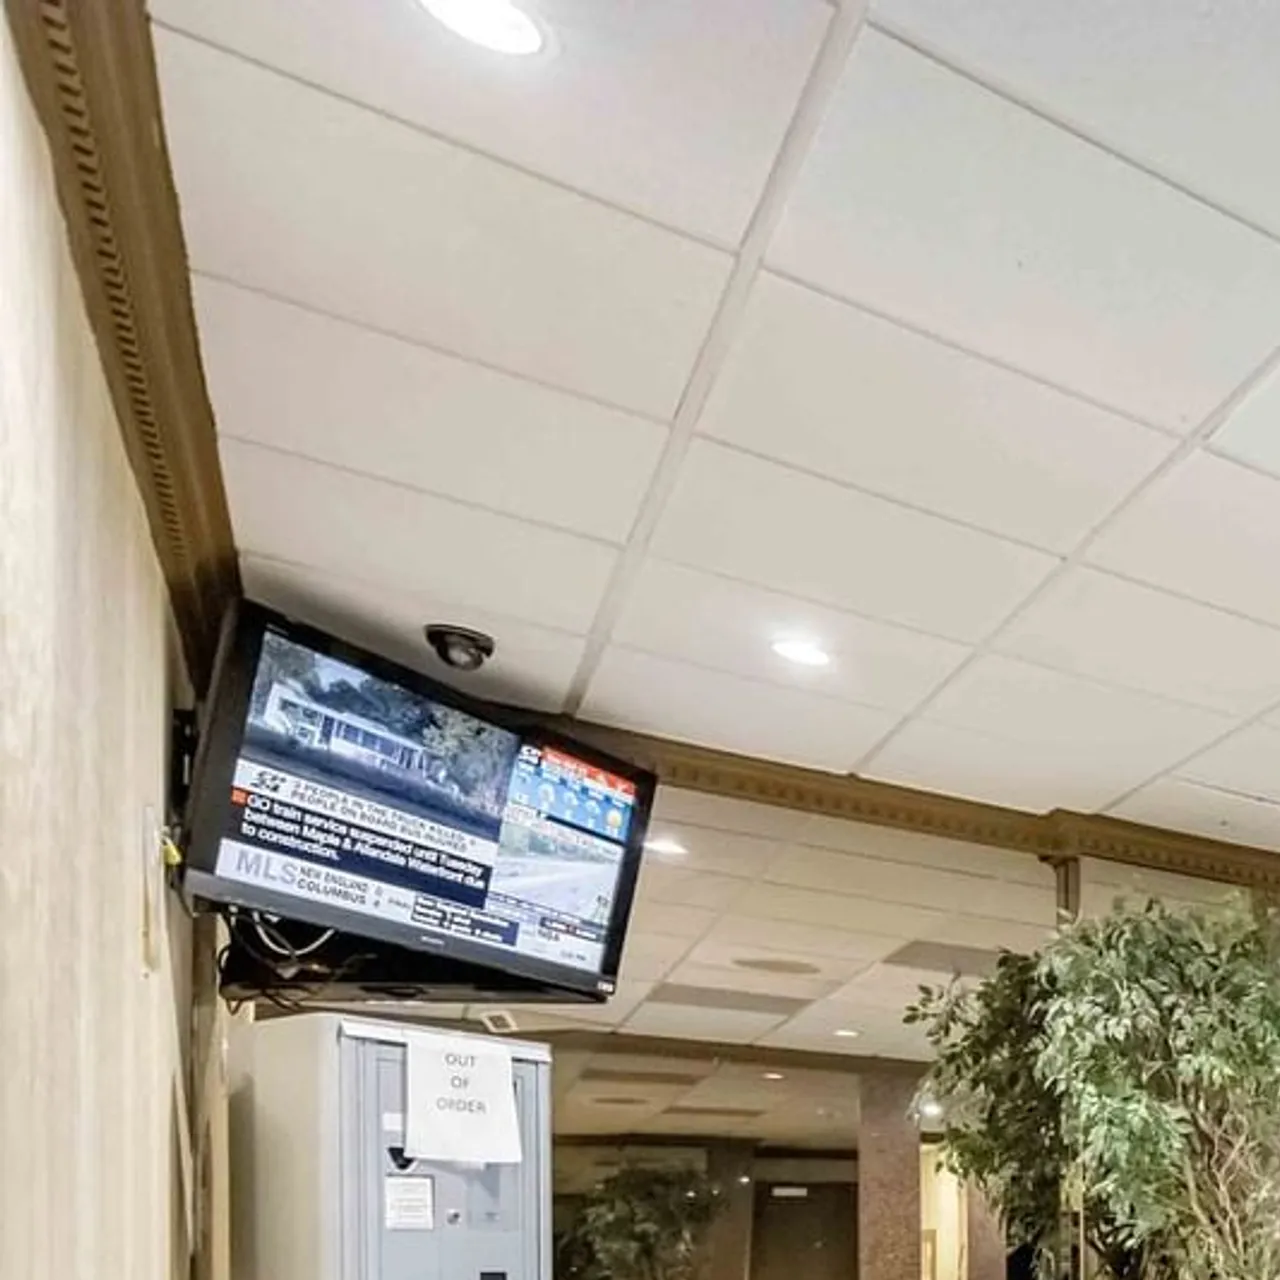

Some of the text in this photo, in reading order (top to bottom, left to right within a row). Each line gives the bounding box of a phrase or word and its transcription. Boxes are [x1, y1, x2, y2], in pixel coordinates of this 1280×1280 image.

[240, 821, 257, 837] to
[245, 793, 483, 878] GO train service suspended until Tuesday
[243, 807, 300, 835] between
[300, 824, 342, 850] Maple
[463, 874, 485, 890] due
[234, 848, 298, 886] MLS
[295, 877, 367, 906] COLUMBUS
[444, 1053, 476, 1068] OUT
[436, 1097, 487, 1115] ORDER
